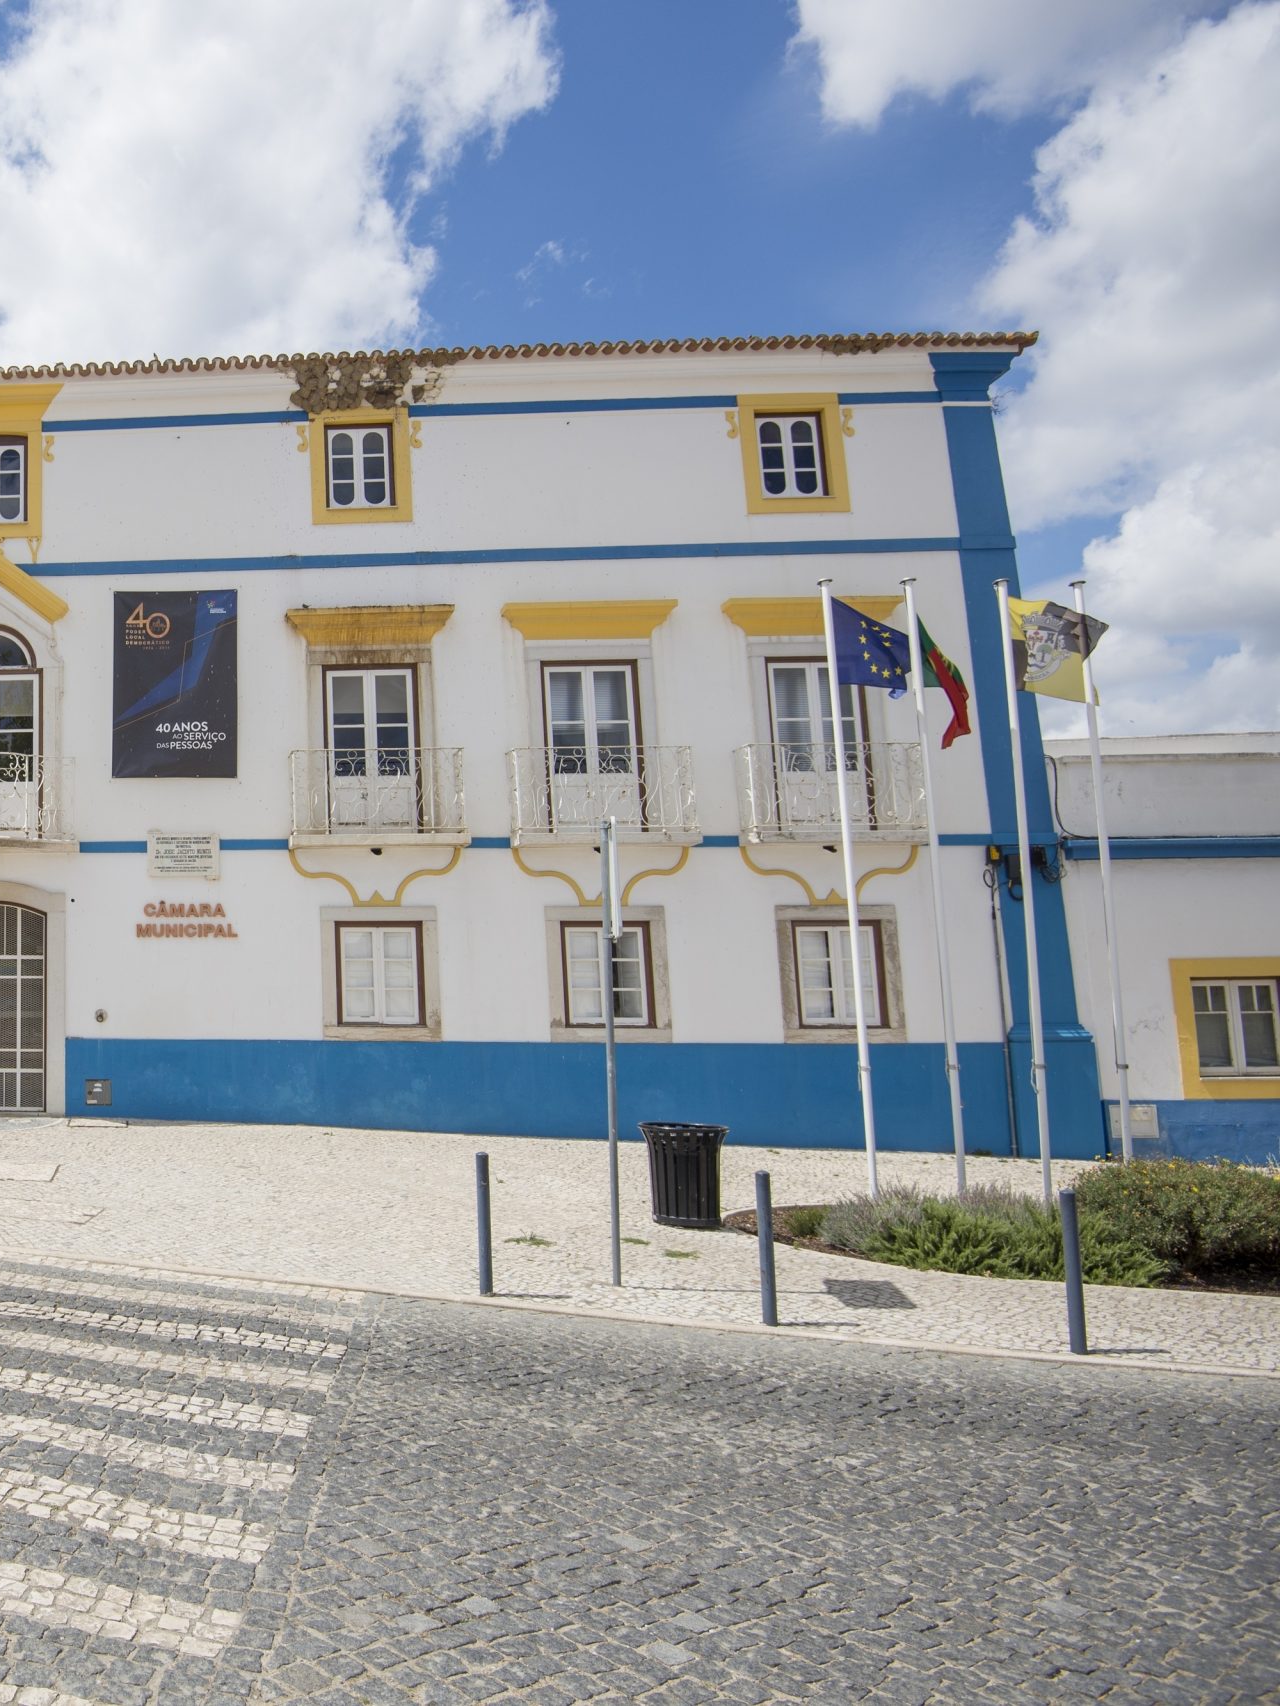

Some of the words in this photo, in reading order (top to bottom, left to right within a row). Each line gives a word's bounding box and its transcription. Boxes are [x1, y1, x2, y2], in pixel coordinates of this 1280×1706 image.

[126, 602, 170, 638] 40
[155, 723, 171, 733] 40
[172, 721, 208, 732] ANOS
[183, 732, 227, 743] SERVIÇO
[170, 741, 213, 749] PESSOAS
[143, 900, 226, 918] CÂMARA
[136, 923, 238, 938] MUNICIPAL
